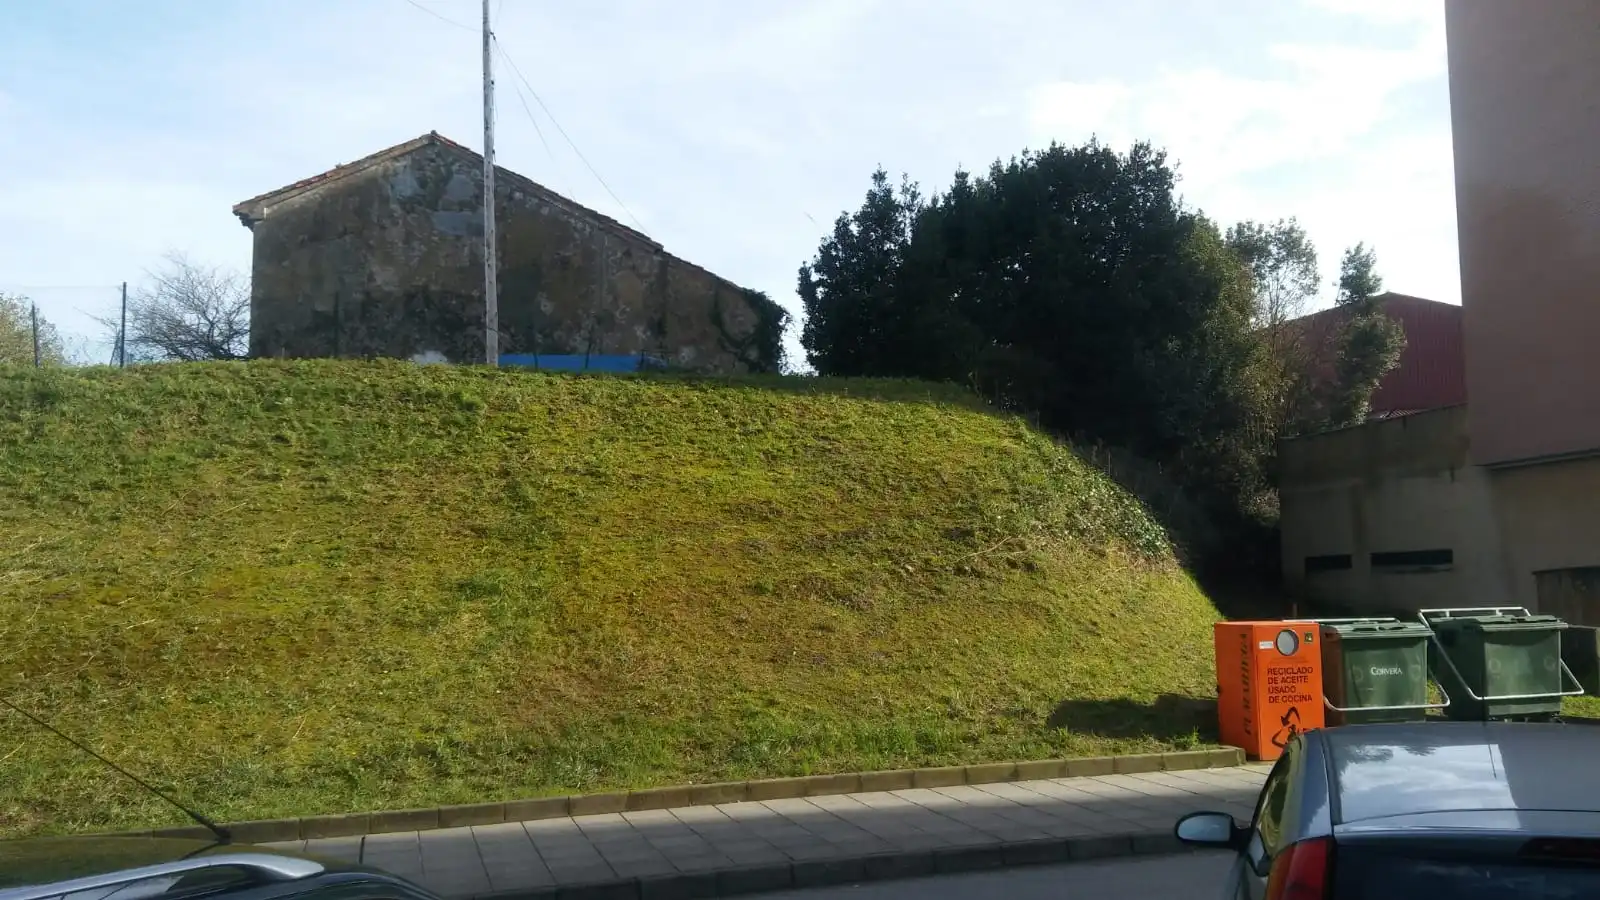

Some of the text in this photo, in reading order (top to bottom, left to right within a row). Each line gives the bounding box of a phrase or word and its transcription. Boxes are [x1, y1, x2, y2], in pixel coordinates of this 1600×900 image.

[1267, 667, 1313, 676] RECICLADO
[1268, 676, 1308, 684] DE ACEITE
[1268, 685, 1296, 694] USADO
[1281, 694, 1313, 703] COCINA
